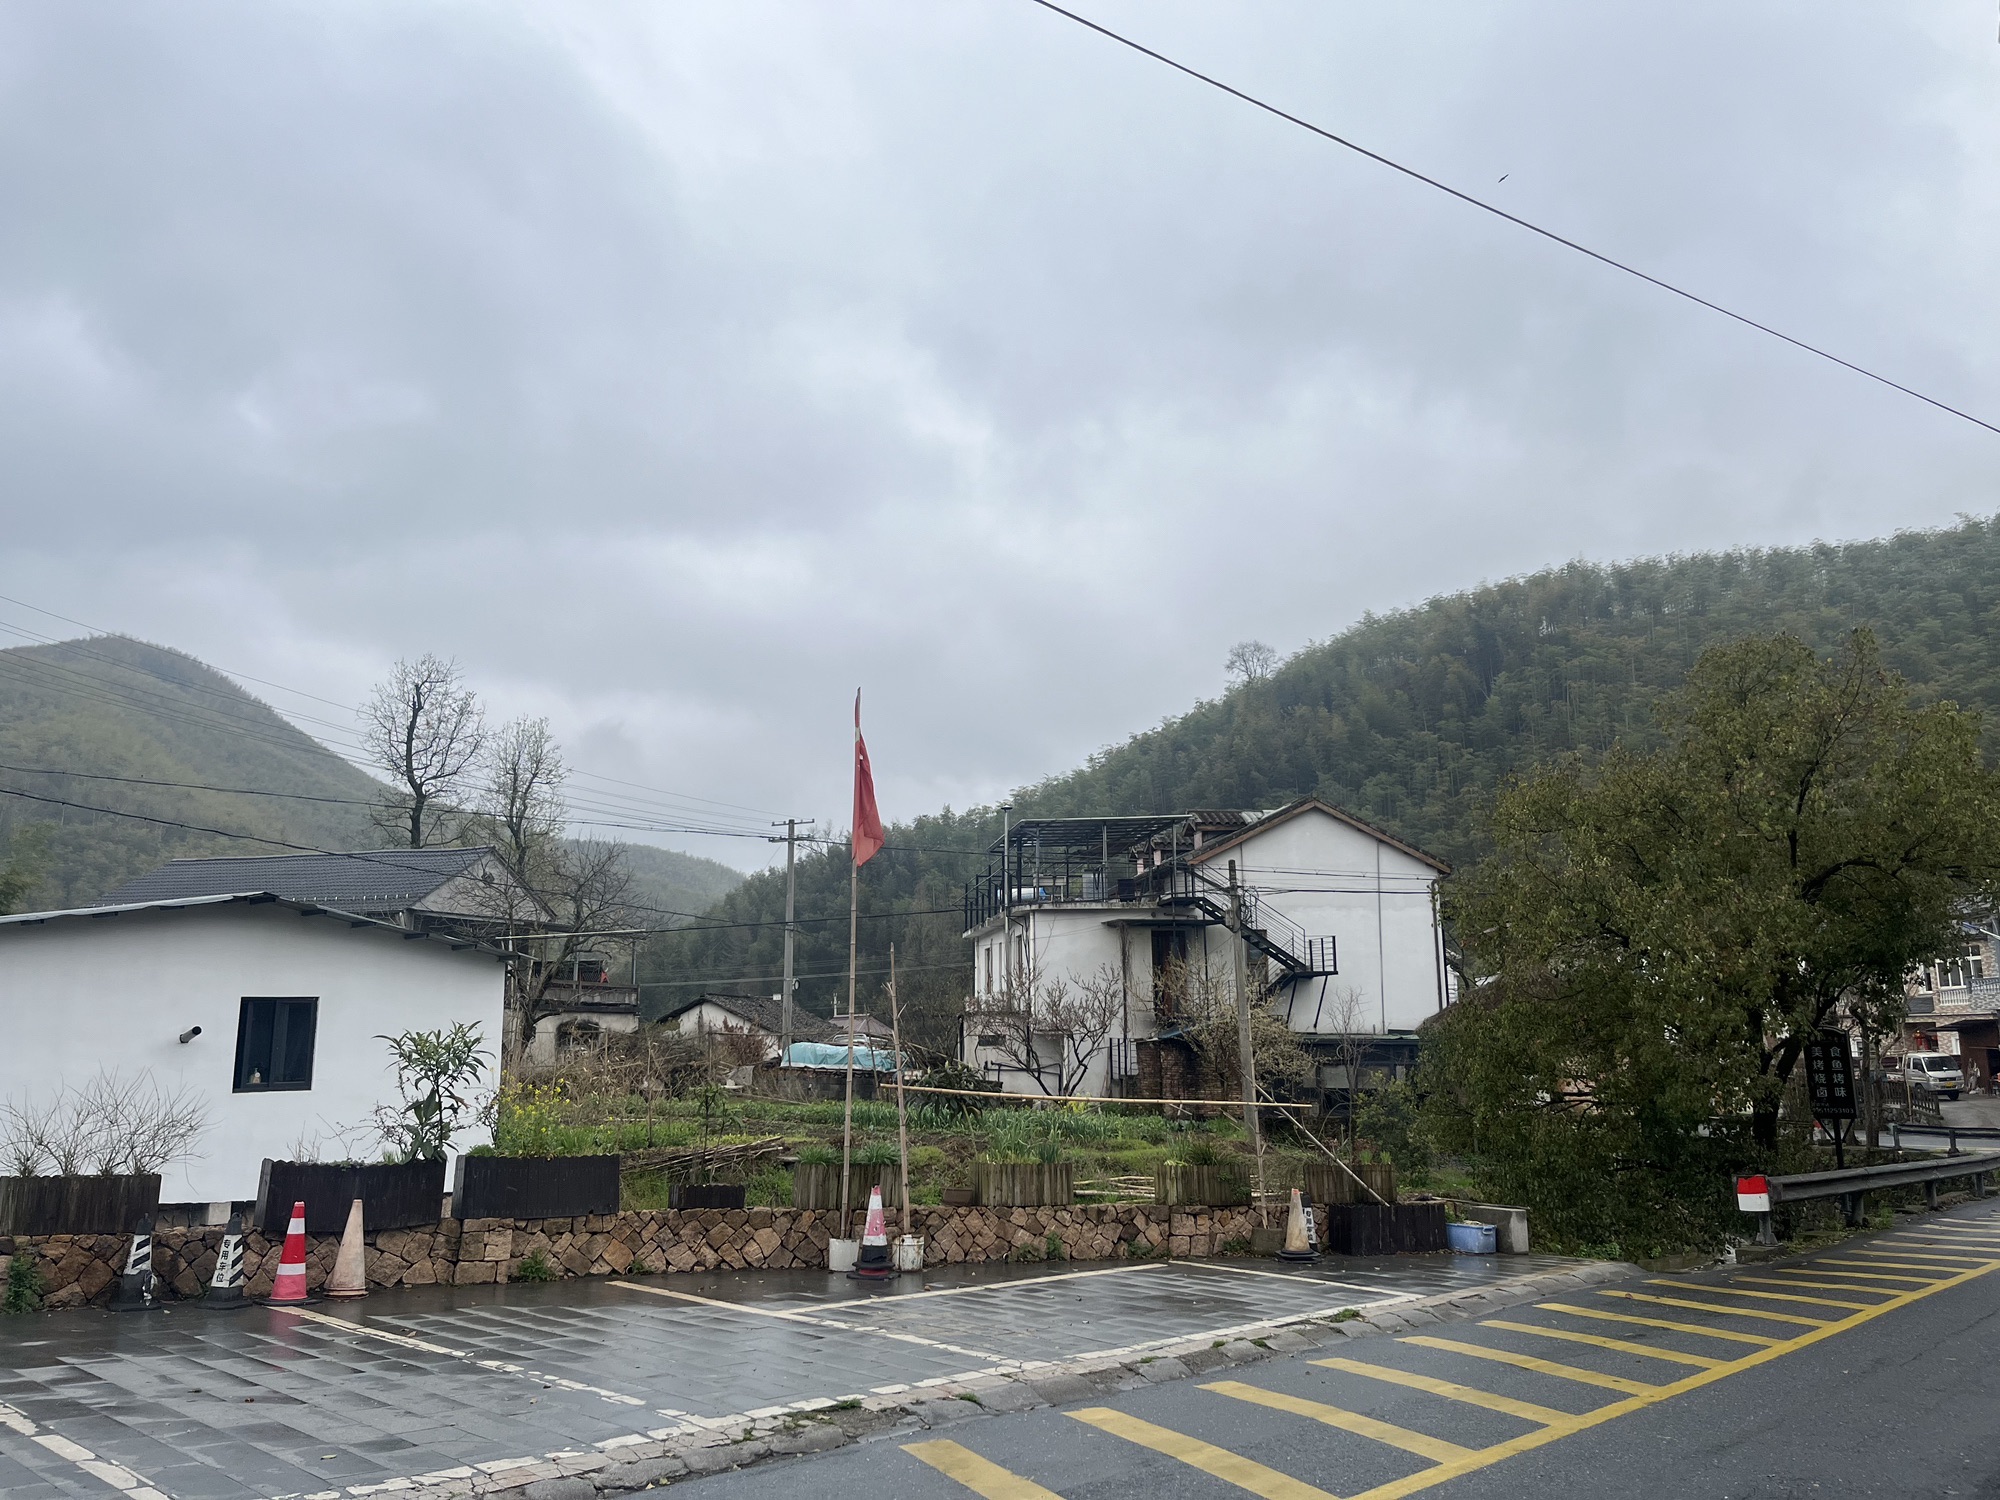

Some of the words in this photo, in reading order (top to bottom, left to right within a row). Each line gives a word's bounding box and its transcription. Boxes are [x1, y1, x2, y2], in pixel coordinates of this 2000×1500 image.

[1811, 1046, 1841, 1057] 美食
[1813, 1060, 1843, 1070] 烤鱼
[1813, 1073, 1845, 1084] 烧烤
[1817, 1087, 1847, 1097] 卤味
[216, 1239, 231, 1282] 专用车位
